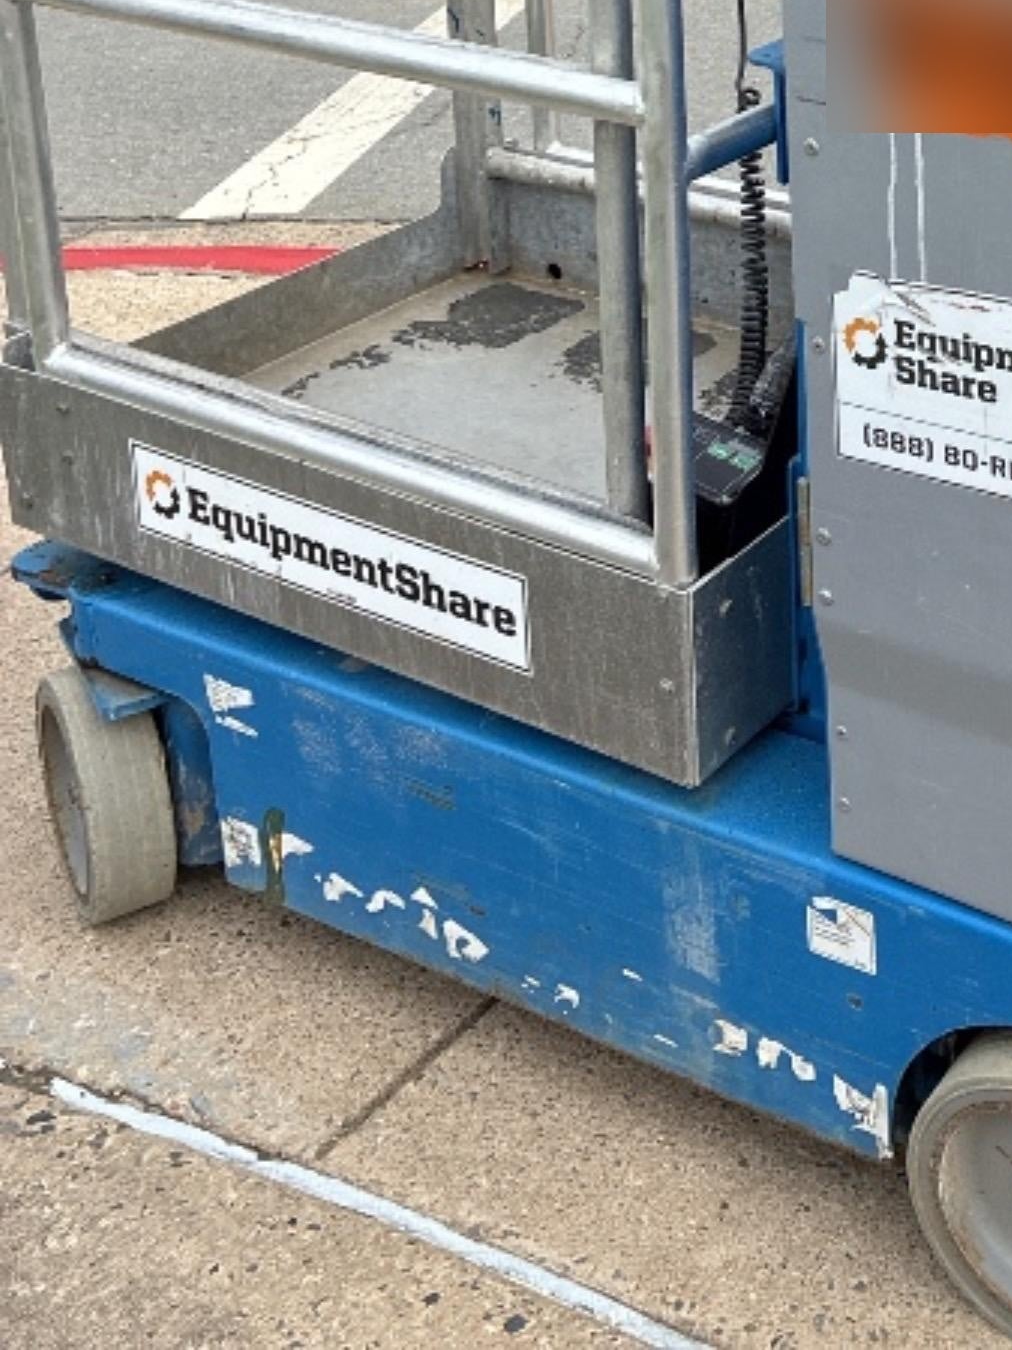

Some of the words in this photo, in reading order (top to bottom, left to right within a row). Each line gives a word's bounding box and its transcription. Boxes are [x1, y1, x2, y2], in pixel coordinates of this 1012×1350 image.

[894, 355, 998, 404] Share
[863, 422, 935, 462] (888)
[186, 485, 517, 637] EquipmentShare
